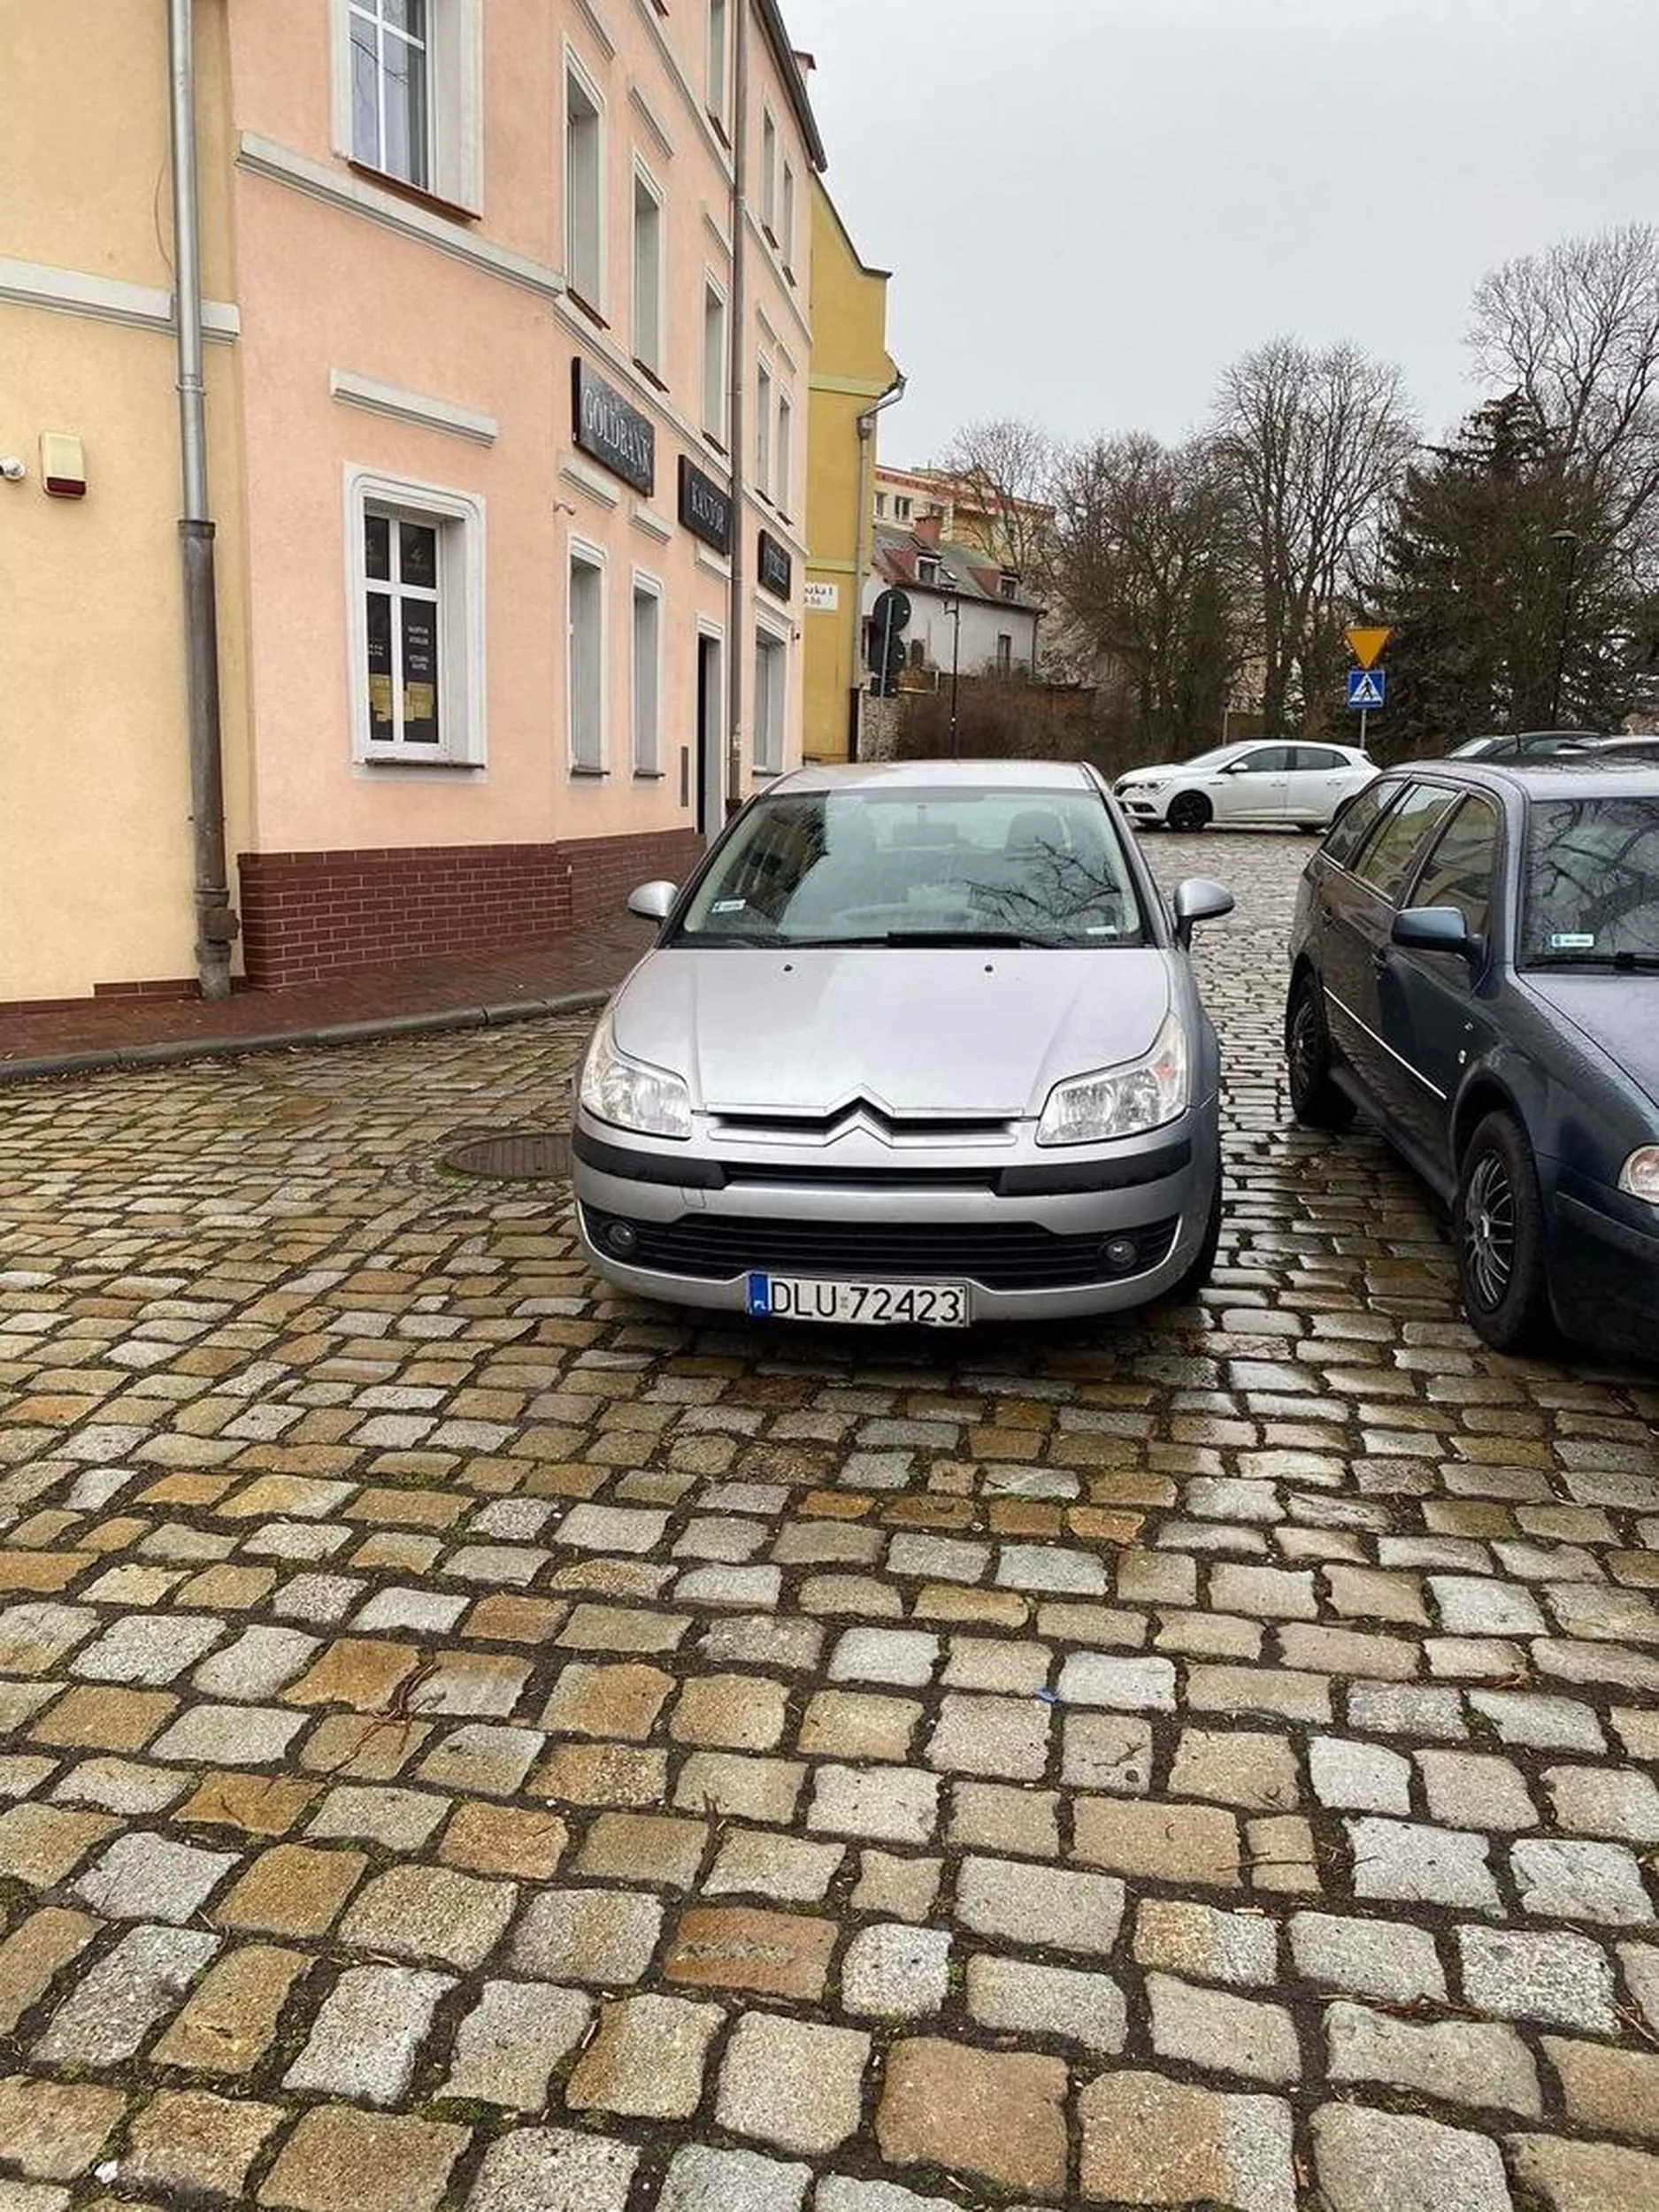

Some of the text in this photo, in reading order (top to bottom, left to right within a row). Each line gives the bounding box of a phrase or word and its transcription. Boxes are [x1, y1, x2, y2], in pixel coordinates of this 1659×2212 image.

[584, 388, 651, 476] GOLDBANK
[771, 1282, 960, 1323] DLU 72423
